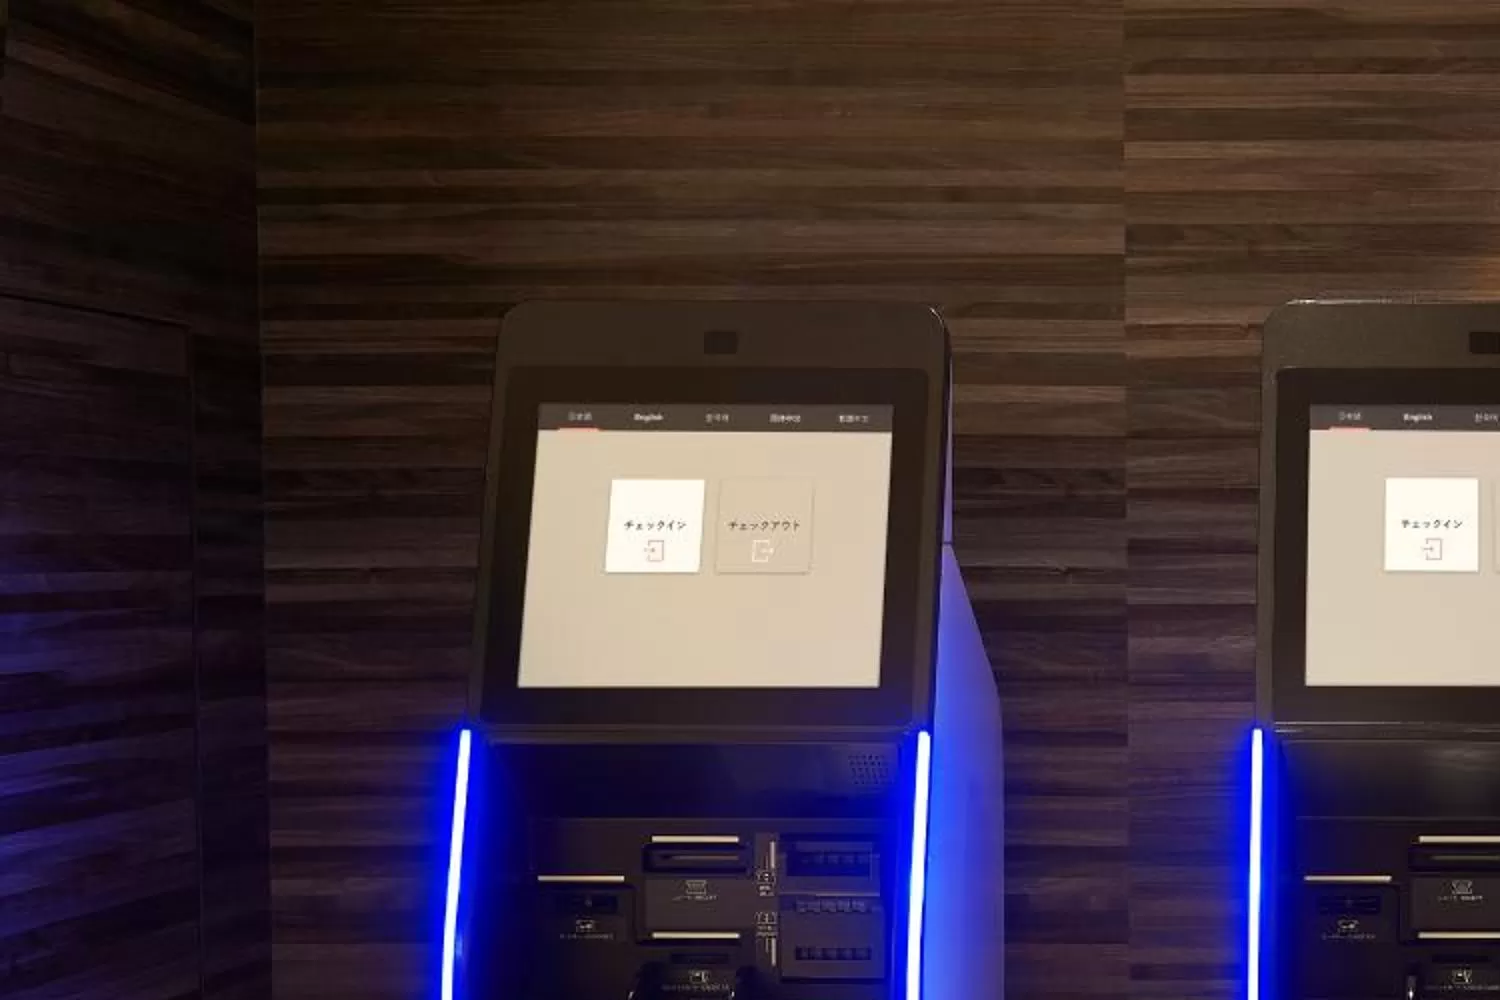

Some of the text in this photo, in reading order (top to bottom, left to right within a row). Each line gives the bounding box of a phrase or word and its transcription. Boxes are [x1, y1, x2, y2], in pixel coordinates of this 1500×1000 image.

[624, 519, 687, 531] チェックイン
[727, 519, 801, 531] チェックアウト
[1401, 519, 1463, 529] チェックイン
